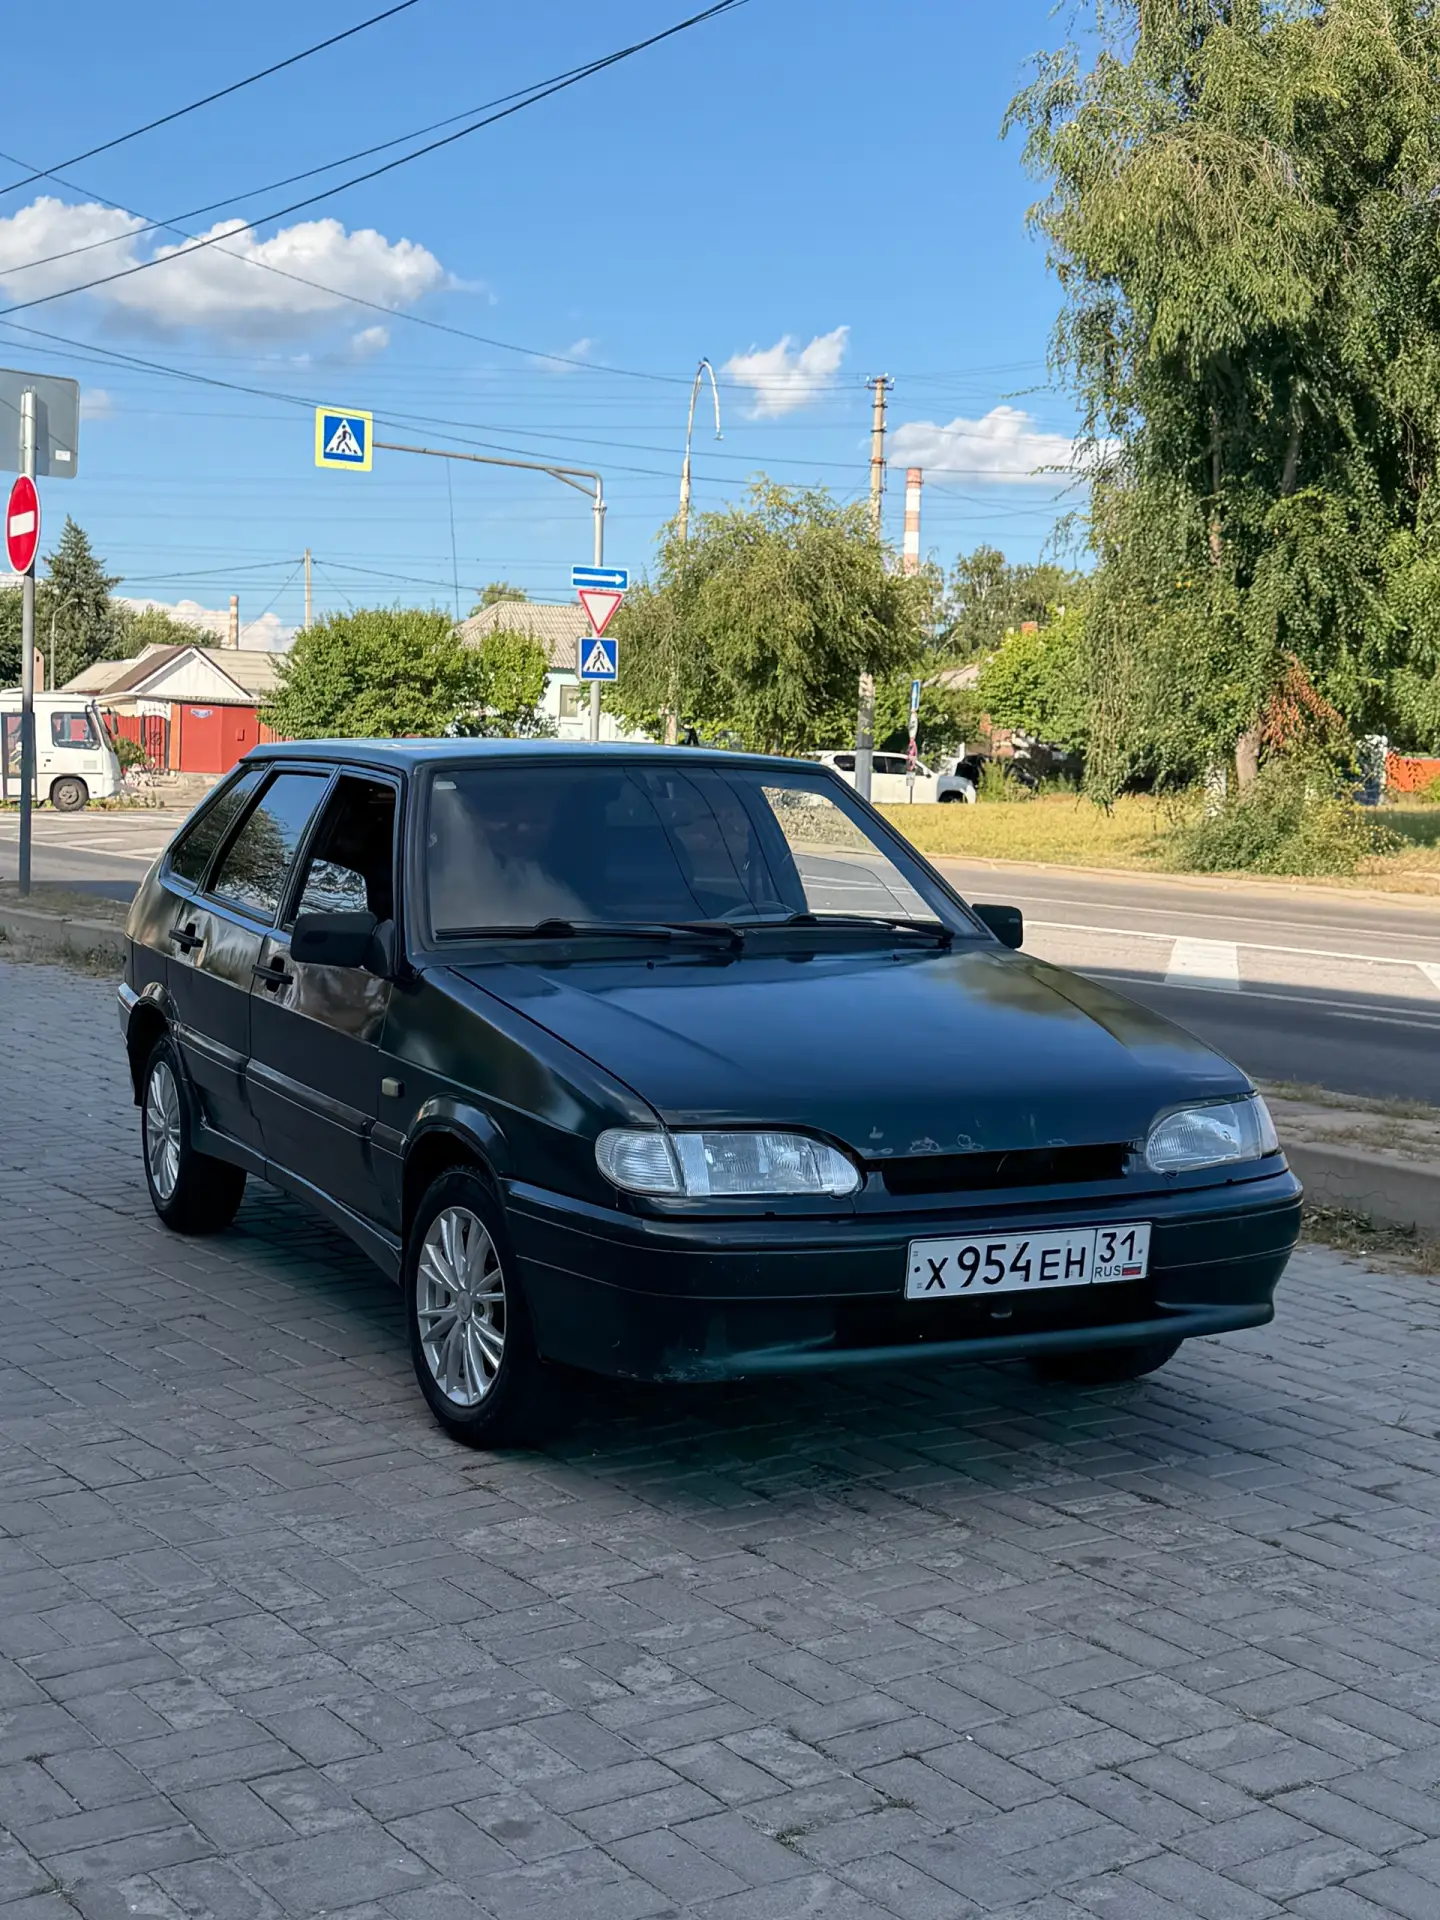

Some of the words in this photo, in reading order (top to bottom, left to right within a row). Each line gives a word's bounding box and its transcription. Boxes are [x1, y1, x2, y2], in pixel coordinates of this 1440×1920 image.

[924, 1241, 1087, 1291] Х954ЕН
[1099, 1230, 1136, 1263] 31
[1094, 1264, 1121, 1278] RUS
